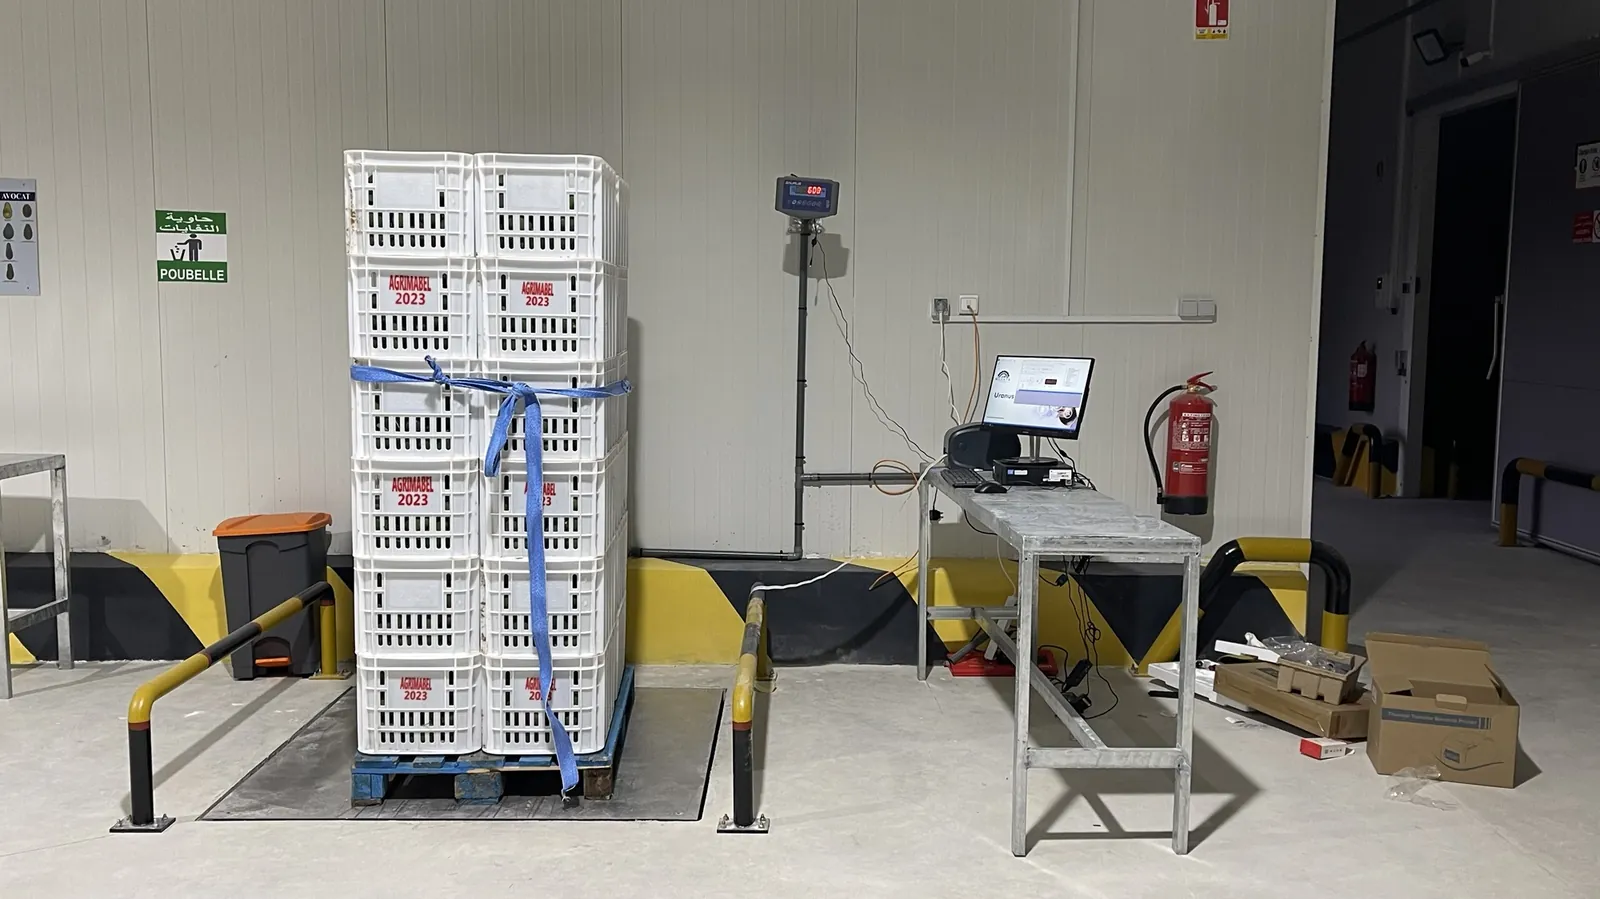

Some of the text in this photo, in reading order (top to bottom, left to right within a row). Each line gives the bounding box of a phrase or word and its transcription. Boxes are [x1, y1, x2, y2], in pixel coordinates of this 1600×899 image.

[1, 192, 30, 200] AVOCAT
[165, 212, 213, 223] حاوية
[159, 224, 220, 233] النفايات
[160, 268, 225, 281] POUBELLE
[388, 274, 432, 292] AGRIMABEL
[521, 281, 554, 297] AGRIMABEL
[395, 292, 426, 306] 2023
[525, 295, 550, 307] 2023
[994, 391, 1015, 400] Uranus
[391, 475, 434, 493] AGRIMABEL
[397, 493, 428, 506] 2023
[400, 676, 432, 691] AGRIMABEL
[404, 690, 428, 701] 2023
[528, 691, 552, 701] 203
